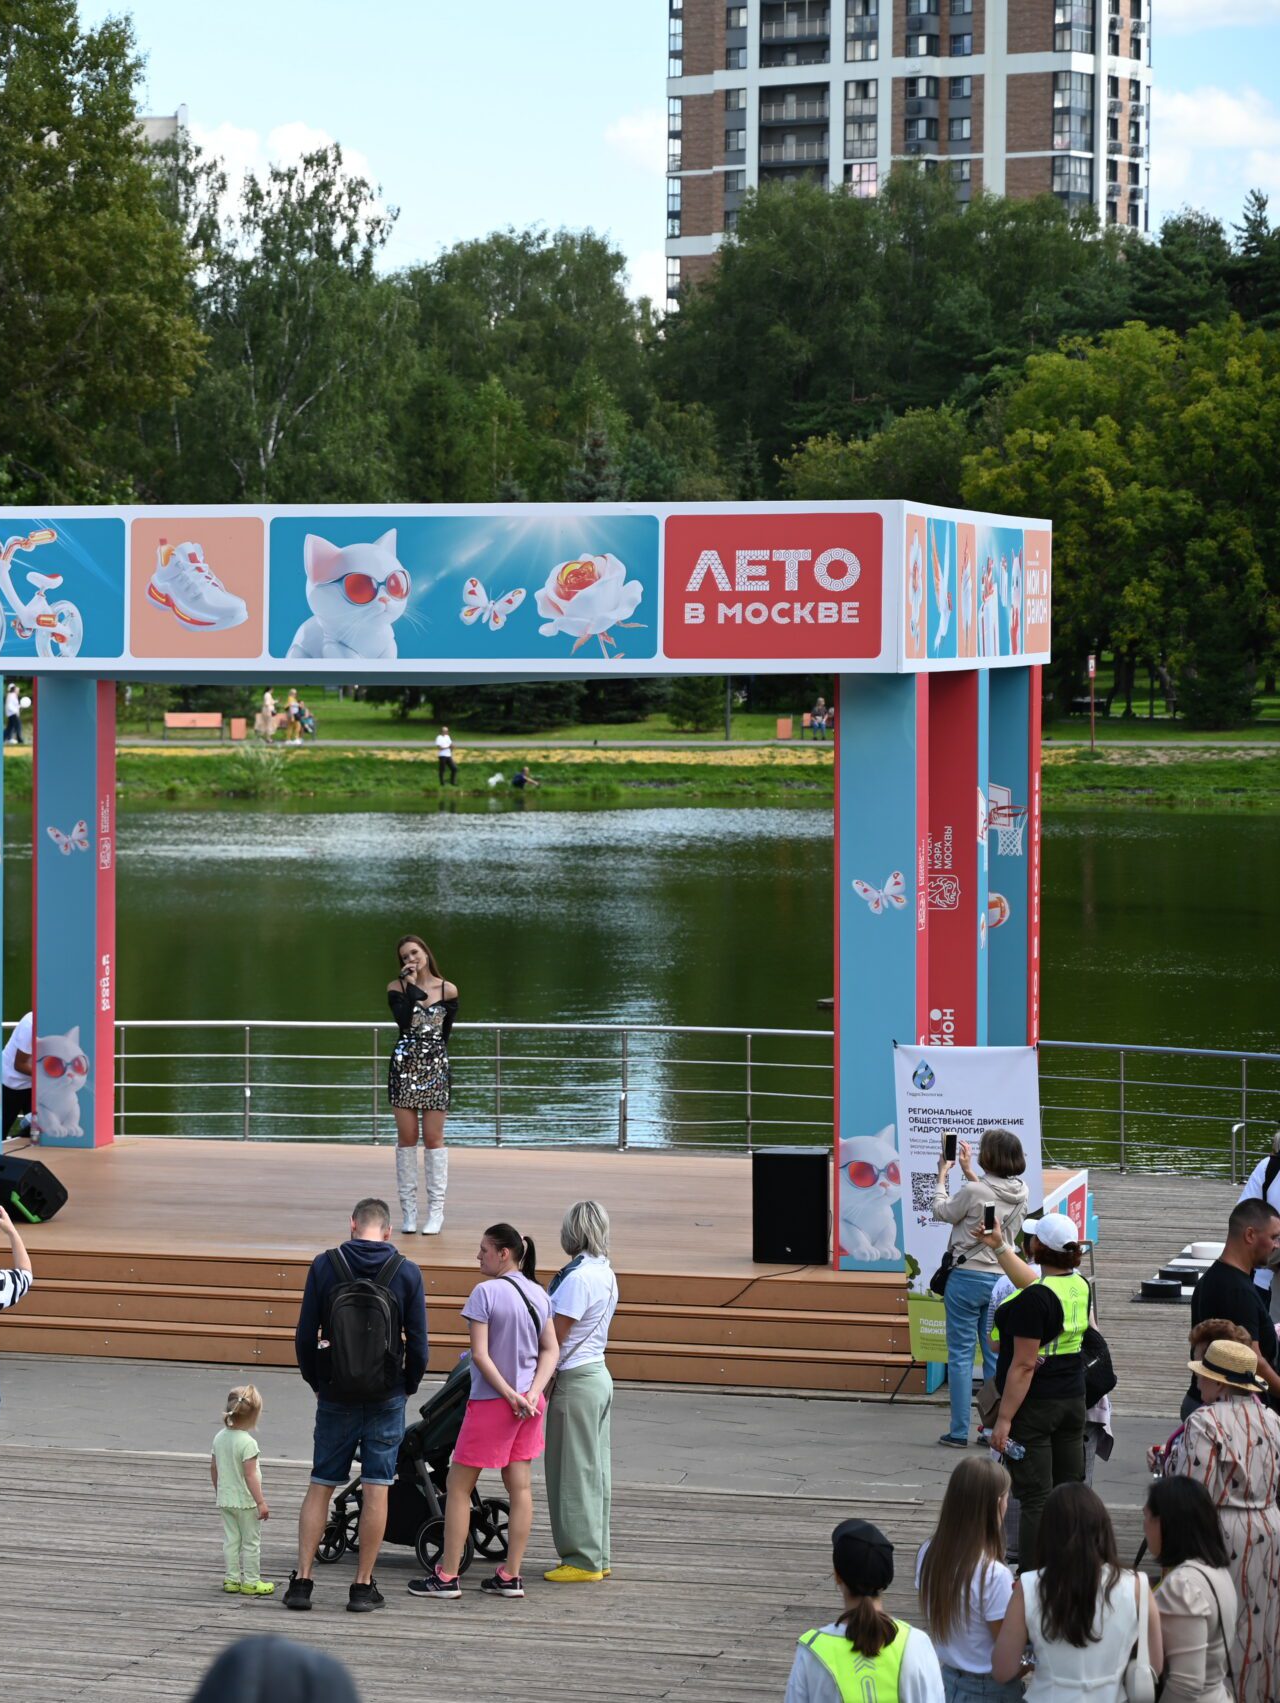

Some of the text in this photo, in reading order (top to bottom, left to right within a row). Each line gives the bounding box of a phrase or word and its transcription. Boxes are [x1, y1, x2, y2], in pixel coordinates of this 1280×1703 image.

[685, 547, 861, 592] ЛЕТО
[684, 601, 860, 625] В МОСКВЕ
[934, 841, 943, 869] МЭРА
[944, 825, 953, 869] МОСКВЫ
[908, 1107, 973, 1116] РЕГИОНАЛЬНОЕ
[908, 1116, 1025, 1126] ОБЩЕСТВЕННОЕ ДВИЖЕНИЕ
[909, 1126, 985, 1135] «ГИДРОЭКОЛОГИЯ
